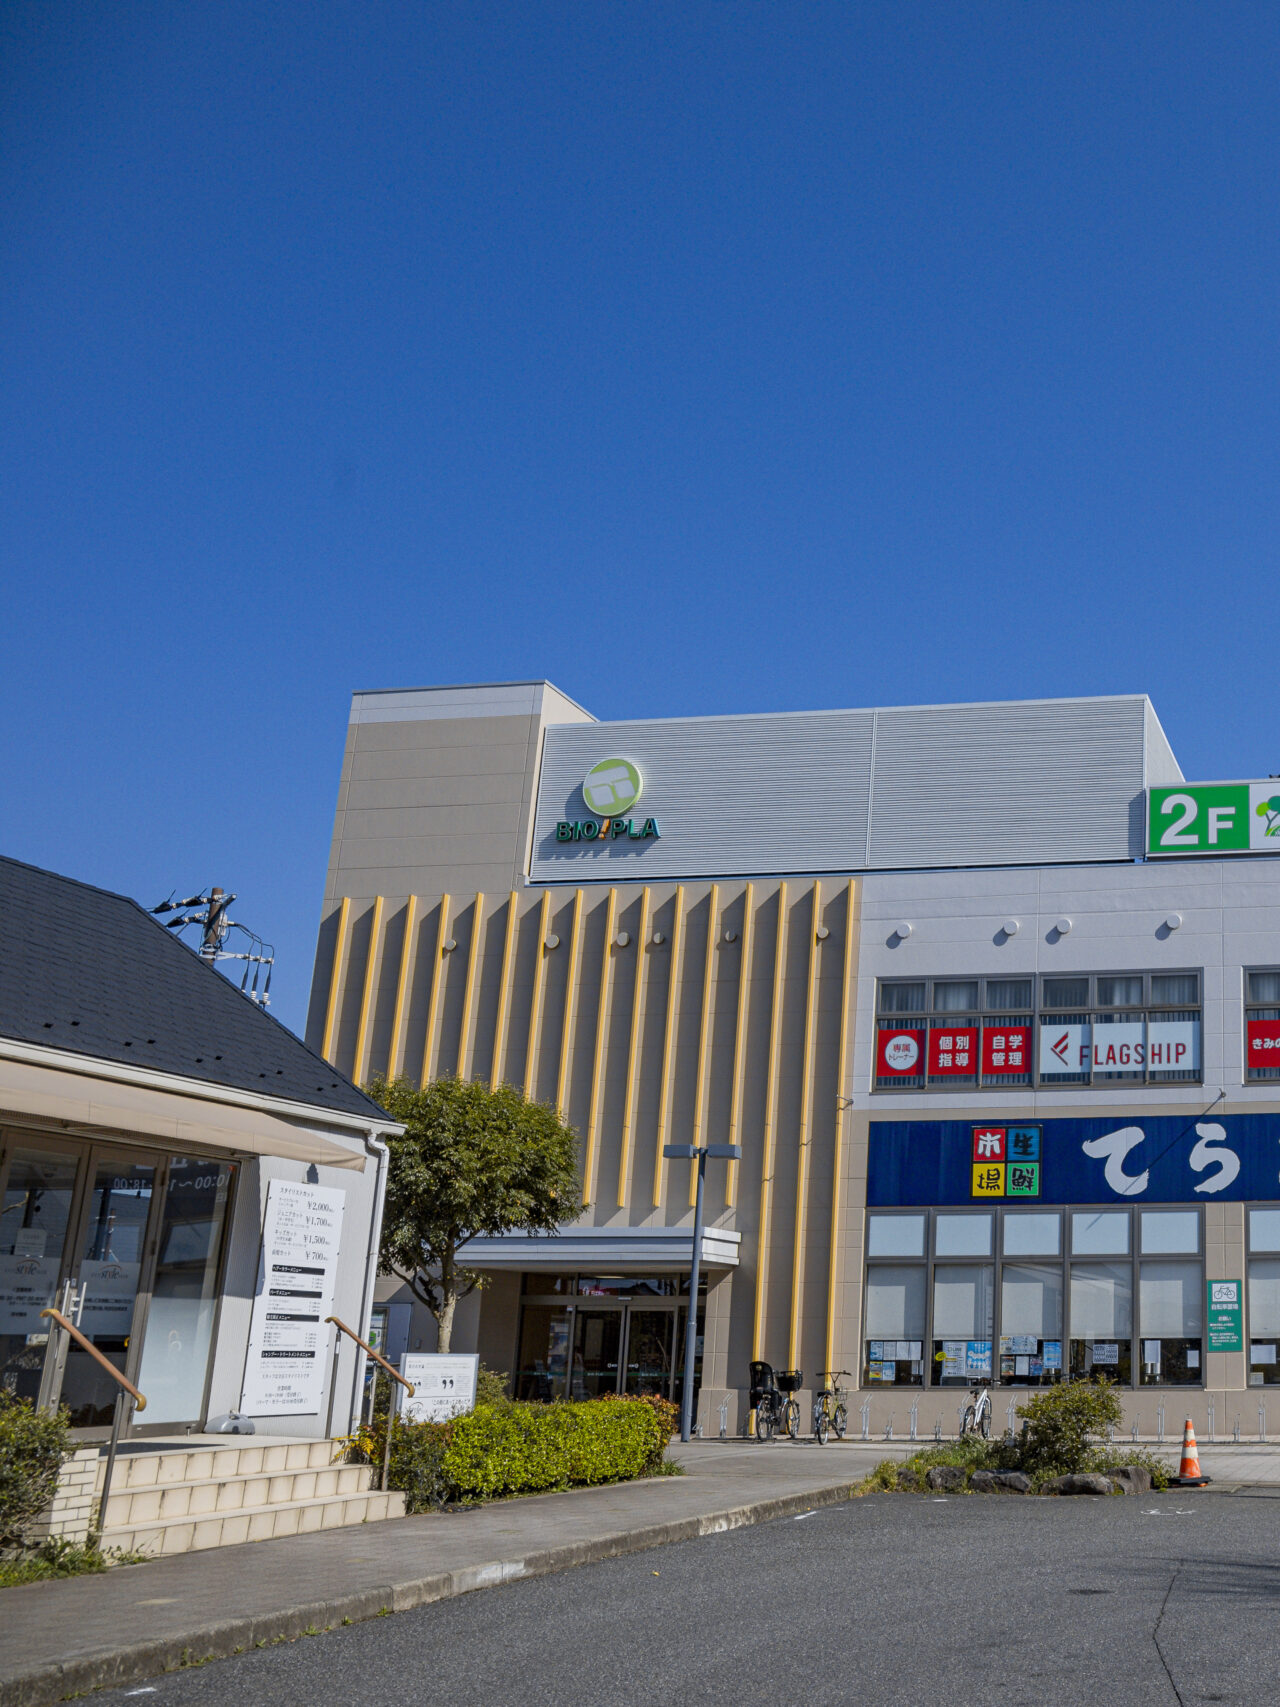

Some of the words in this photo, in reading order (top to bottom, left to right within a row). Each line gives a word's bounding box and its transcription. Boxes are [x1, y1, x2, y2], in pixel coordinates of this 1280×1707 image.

[1160, 793, 1236, 846] 2F
[939, 1035, 970, 1050] 個別
[992, 1035, 1023, 1050] 自学
[888, 1053, 915, 1061] トレーナー
[938, 1052, 969, 1067] 指導
[992, 1052, 1023, 1066] 管理
[1079, 1043, 1187, 1067] FLAGSHIP
